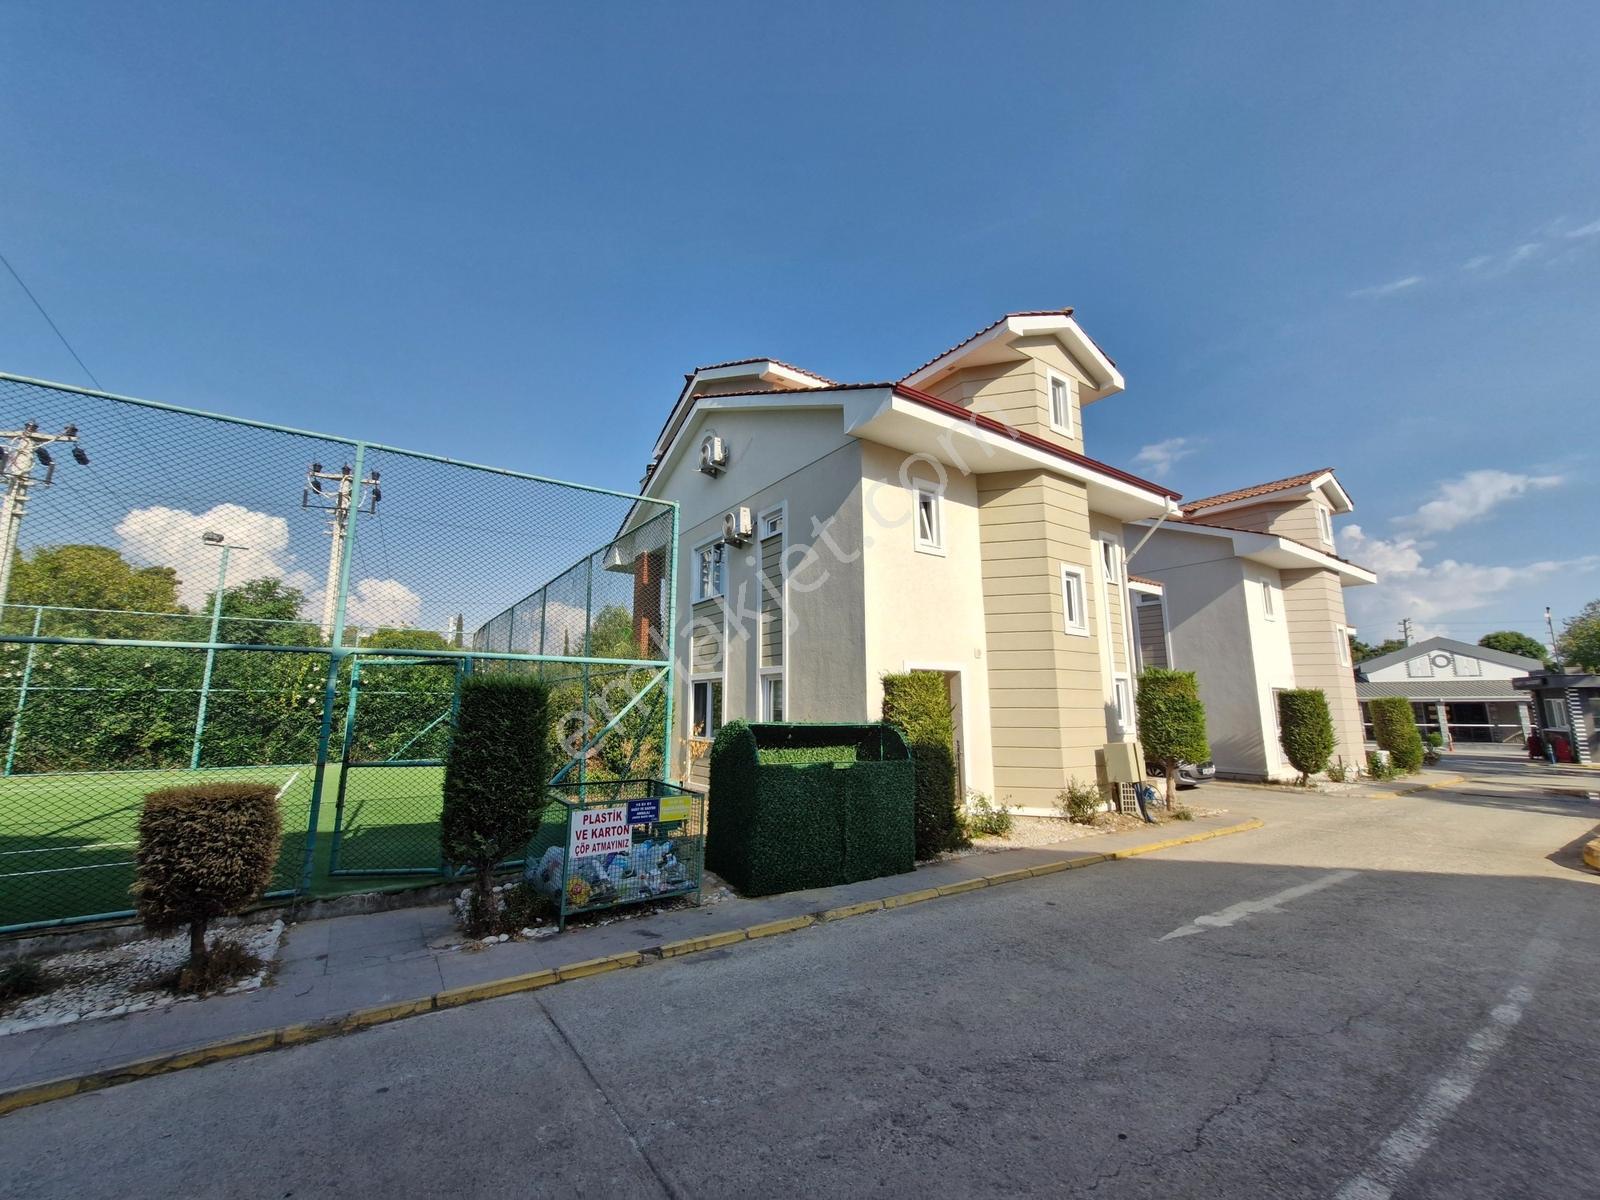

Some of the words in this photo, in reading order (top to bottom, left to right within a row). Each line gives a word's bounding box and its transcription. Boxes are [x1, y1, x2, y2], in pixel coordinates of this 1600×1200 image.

[583, 810, 622, 825] PLASTİK
[575, 829, 588, 841] VE
[591, 825, 630, 840] KARTON
[575, 843, 590, 856] ÇÖP
[591, 839, 630, 852] ATMAYINIZ
